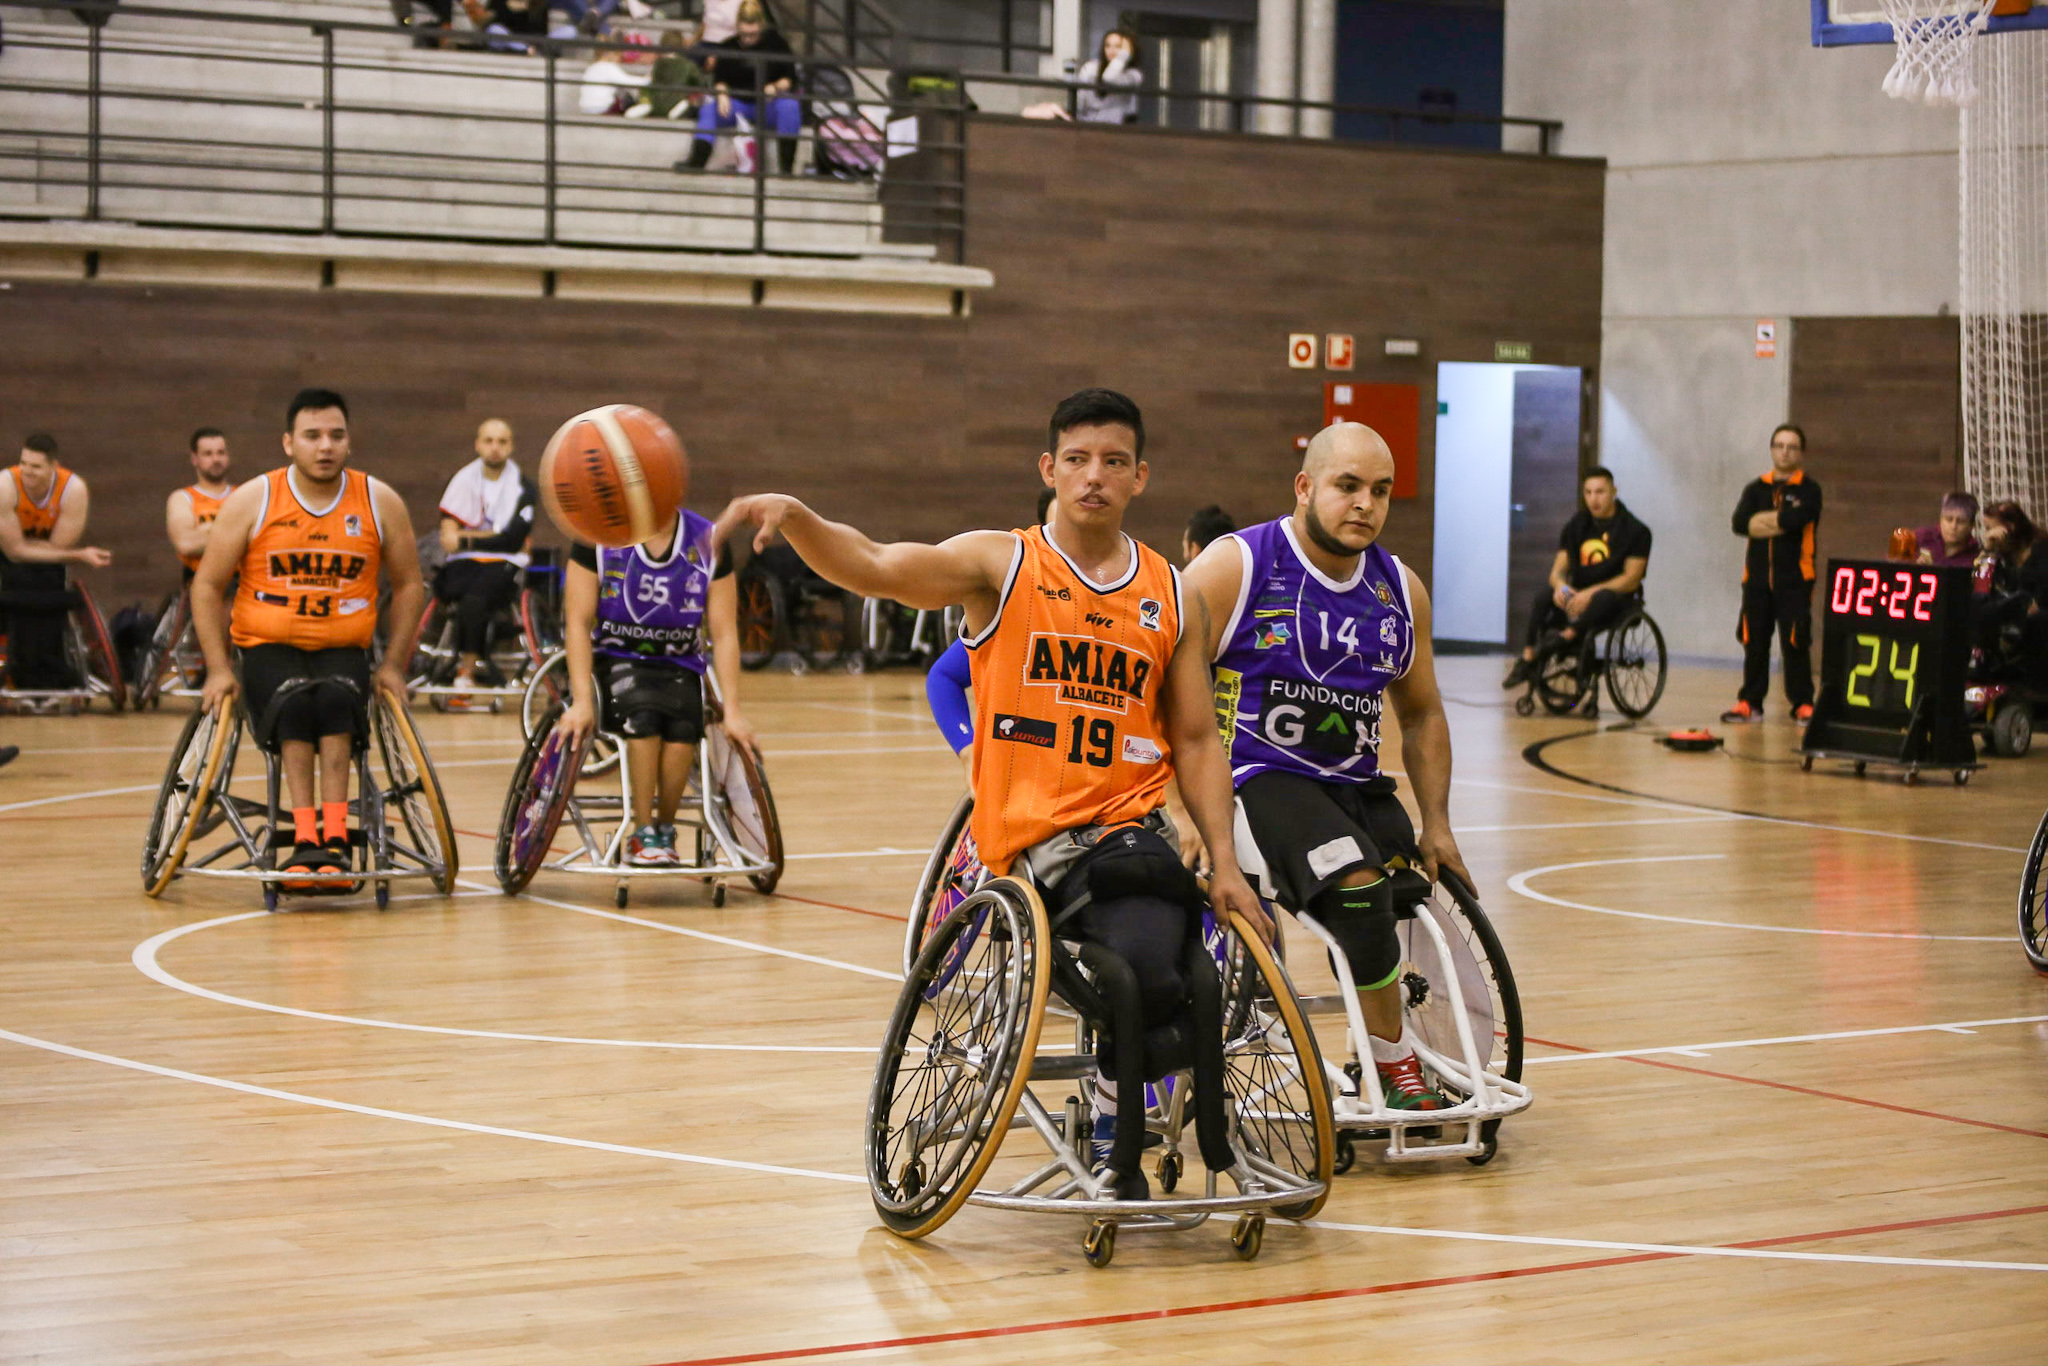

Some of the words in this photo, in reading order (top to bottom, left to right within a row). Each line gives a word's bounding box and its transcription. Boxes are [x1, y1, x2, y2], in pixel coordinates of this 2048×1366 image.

[270, 553, 366, 580] AMIAB
[637, 574, 670, 604] 55
[1832, 567, 1937, 621] 02:22
[296, 595, 332, 617] 13
[1085, 612, 1114, 629] vive
[602, 621, 692, 641] FUNDACIÓN
[1318, 611, 1359, 654] 14
[1847, 634, 1918, 709] 24
[1062, 685, 1125, 708] ALBACETE
[1270, 679, 1380, 716] FUNDACIÓN
[1067, 715, 1115, 767] 19
